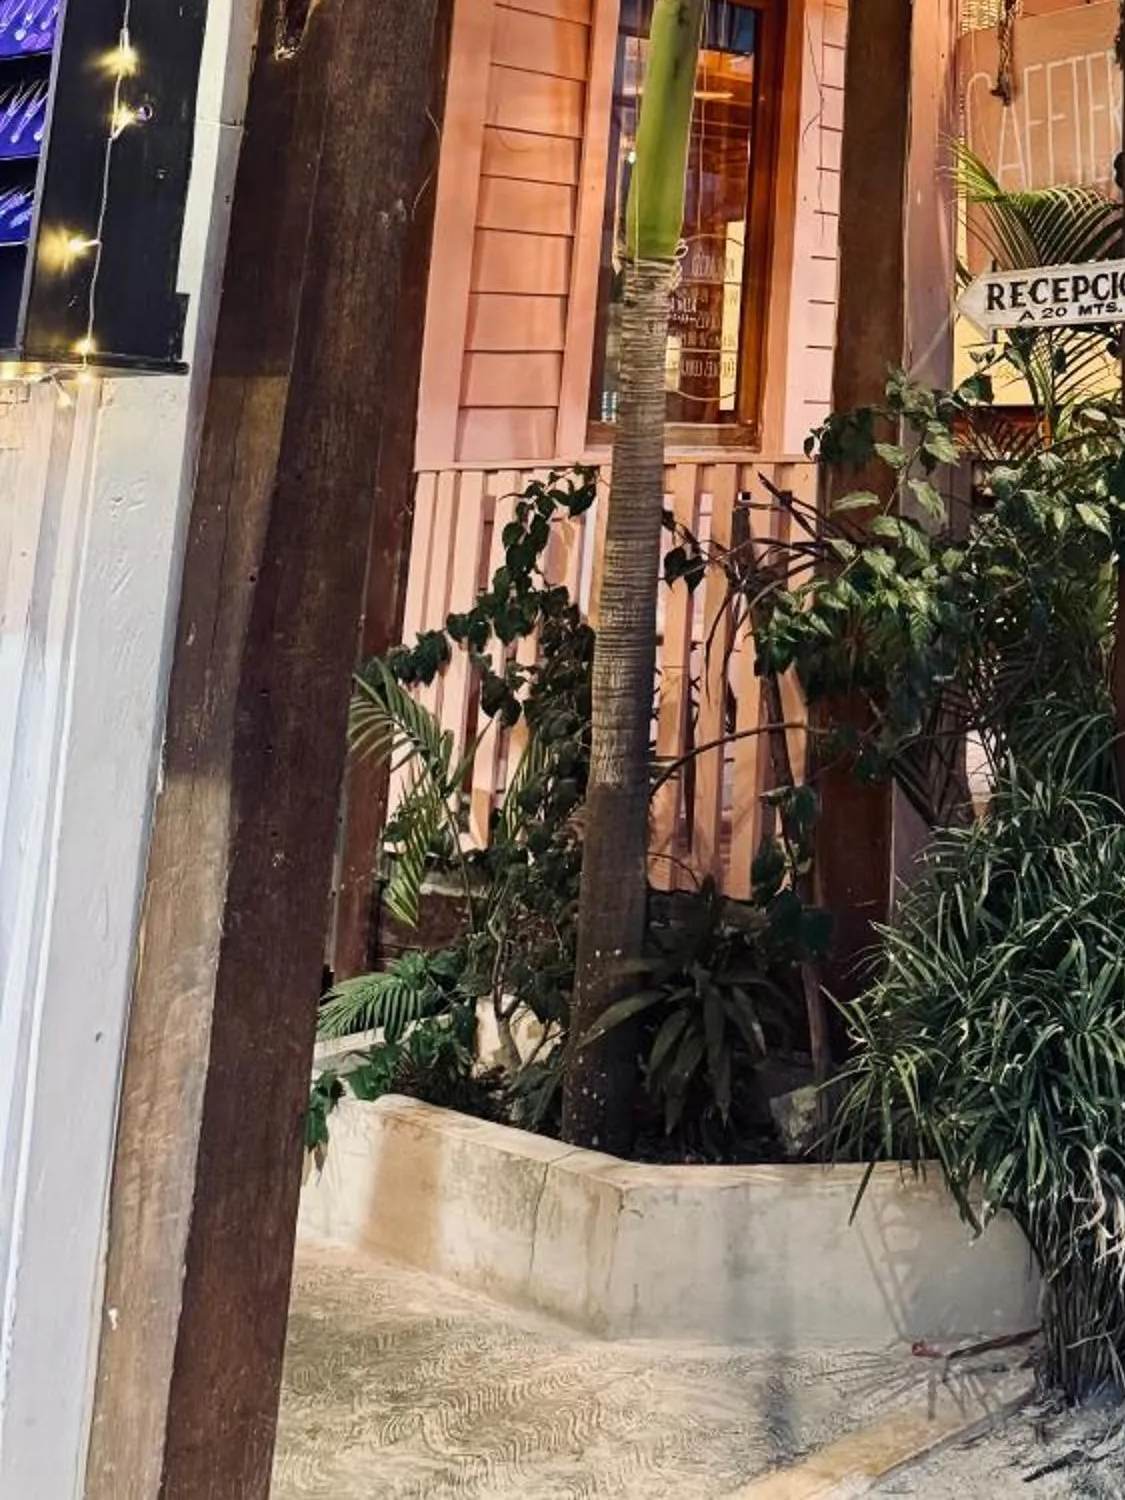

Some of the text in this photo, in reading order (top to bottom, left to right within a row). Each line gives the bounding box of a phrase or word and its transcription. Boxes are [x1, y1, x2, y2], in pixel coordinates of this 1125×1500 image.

[1018, 301, 1123, 323] A 20 MTS.
